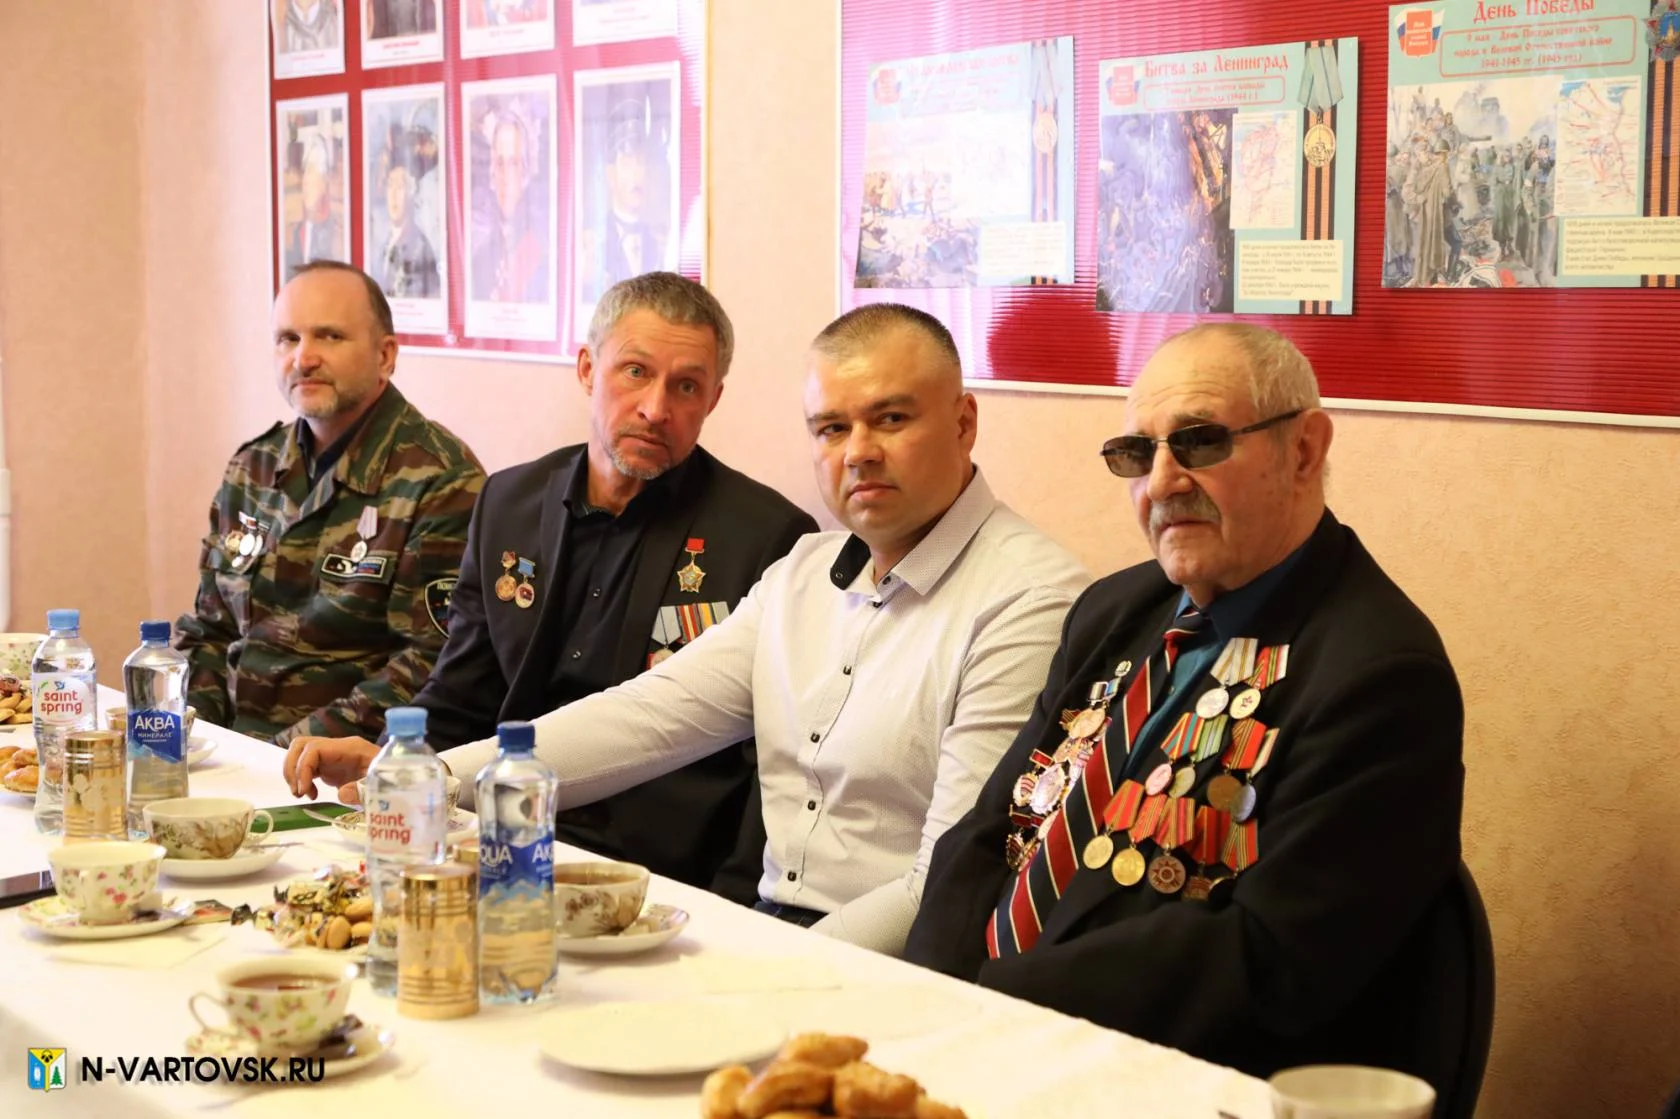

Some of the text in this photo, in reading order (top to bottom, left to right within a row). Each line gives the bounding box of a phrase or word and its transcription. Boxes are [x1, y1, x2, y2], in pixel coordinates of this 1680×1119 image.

[1473, 0, 1517, 24] День
[1213, 54, 1289, 74] Ленинград
[44, 690, 78, 702] saint
[41, 702, 82, 716] spring
[135, 714, 175, 732] АКВА
[369, 826, 411, 846] pring
